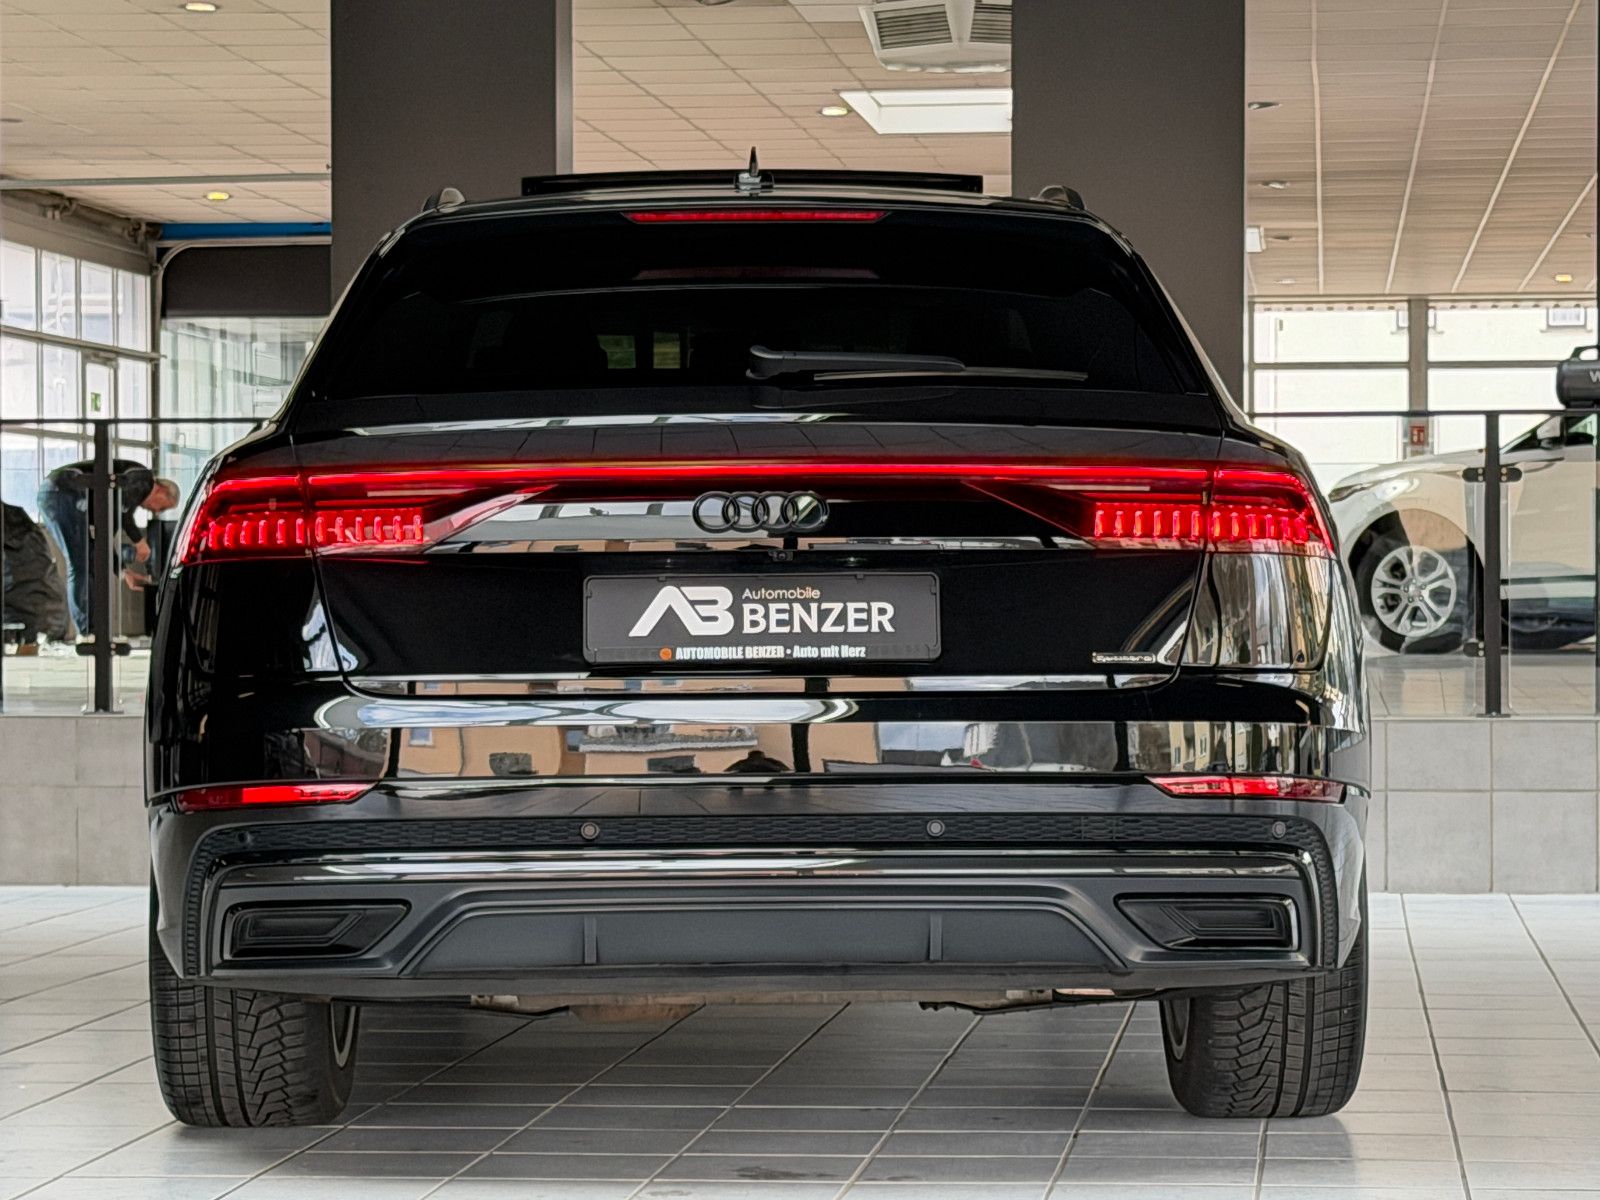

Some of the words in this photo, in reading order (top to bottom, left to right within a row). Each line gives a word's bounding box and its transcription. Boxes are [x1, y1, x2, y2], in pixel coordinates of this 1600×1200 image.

[742, 587, 821, 600] Automobile
[742, 601, 895, 634] BENZER
[675, 646, 744, 660] AUTOMOBILE
[745, 645, 784, 659] BENZER
[793, 645, 816, 658] Auto
[820, 645, 839, 658] mit
[841, 645, 866, 658] Herz
